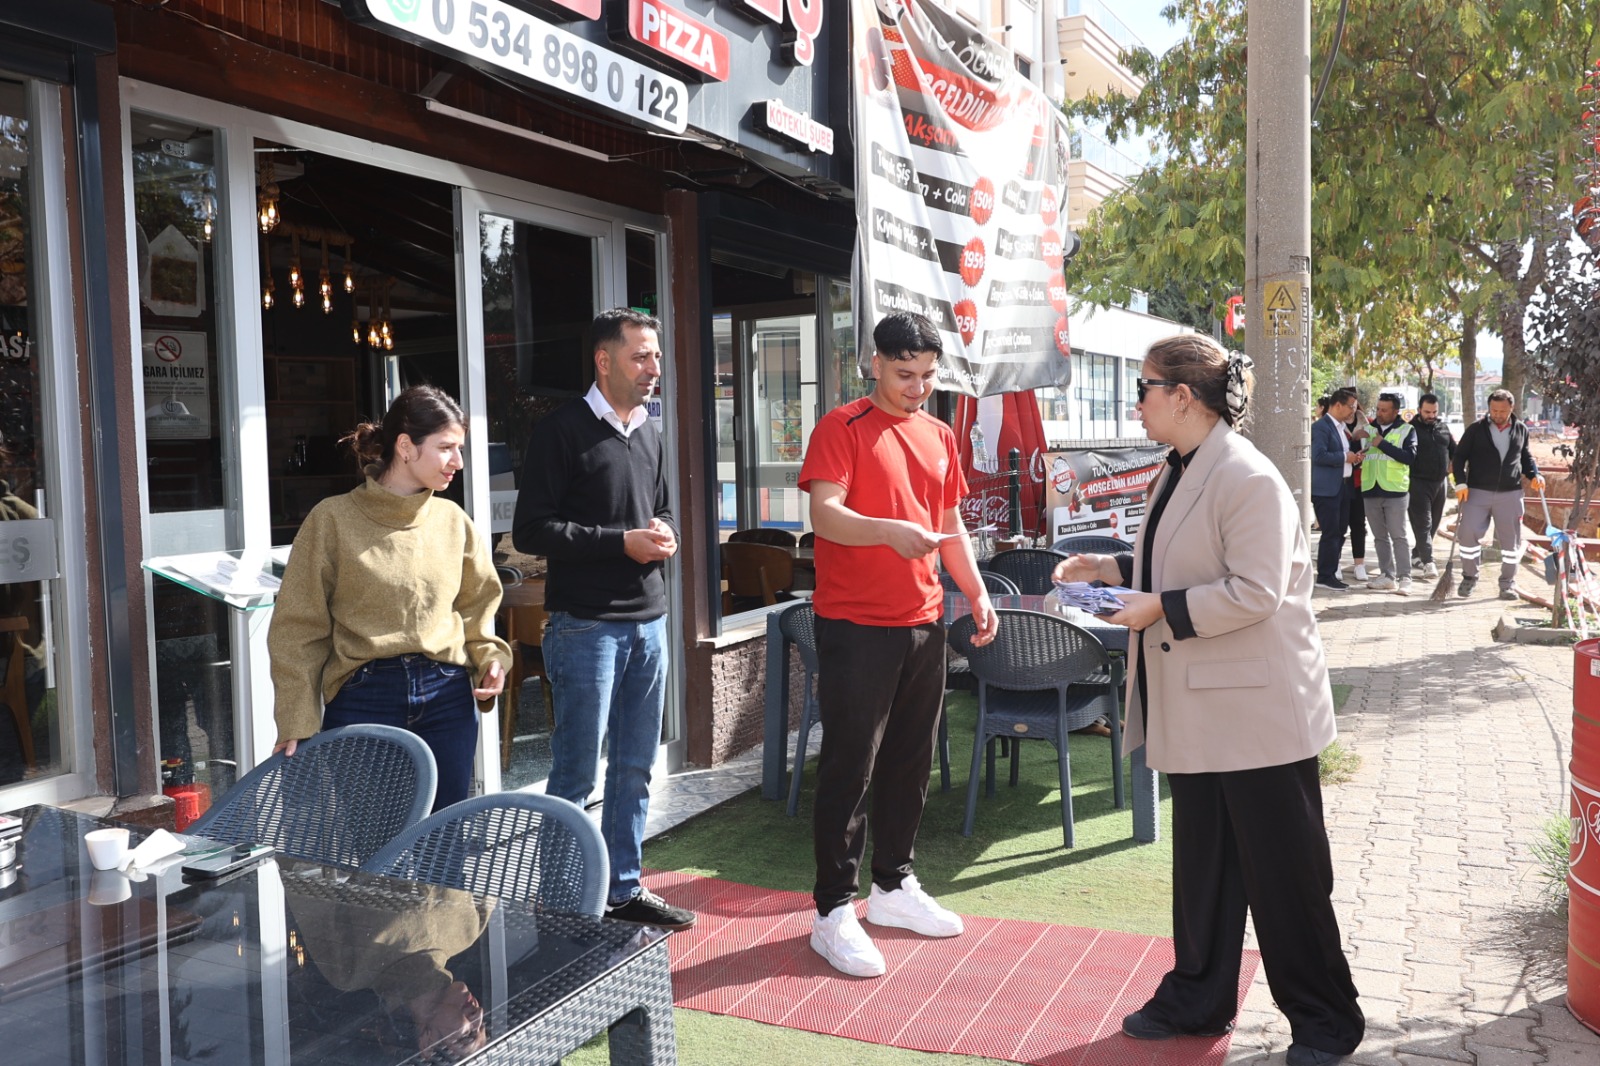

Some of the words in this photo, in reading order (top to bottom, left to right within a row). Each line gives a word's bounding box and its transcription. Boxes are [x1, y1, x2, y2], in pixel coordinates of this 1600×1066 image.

[467, 5, 532, 66] 534
[542, 33, 599, 93] 898
[606, 61, 624, 102] 0
[634, 74, 678, 125] 122
[896, 162, 911, 186] Şiş
[945, 187, 967, 206] Cola
[170, 363, 205, 381] İÇİLMEZ
